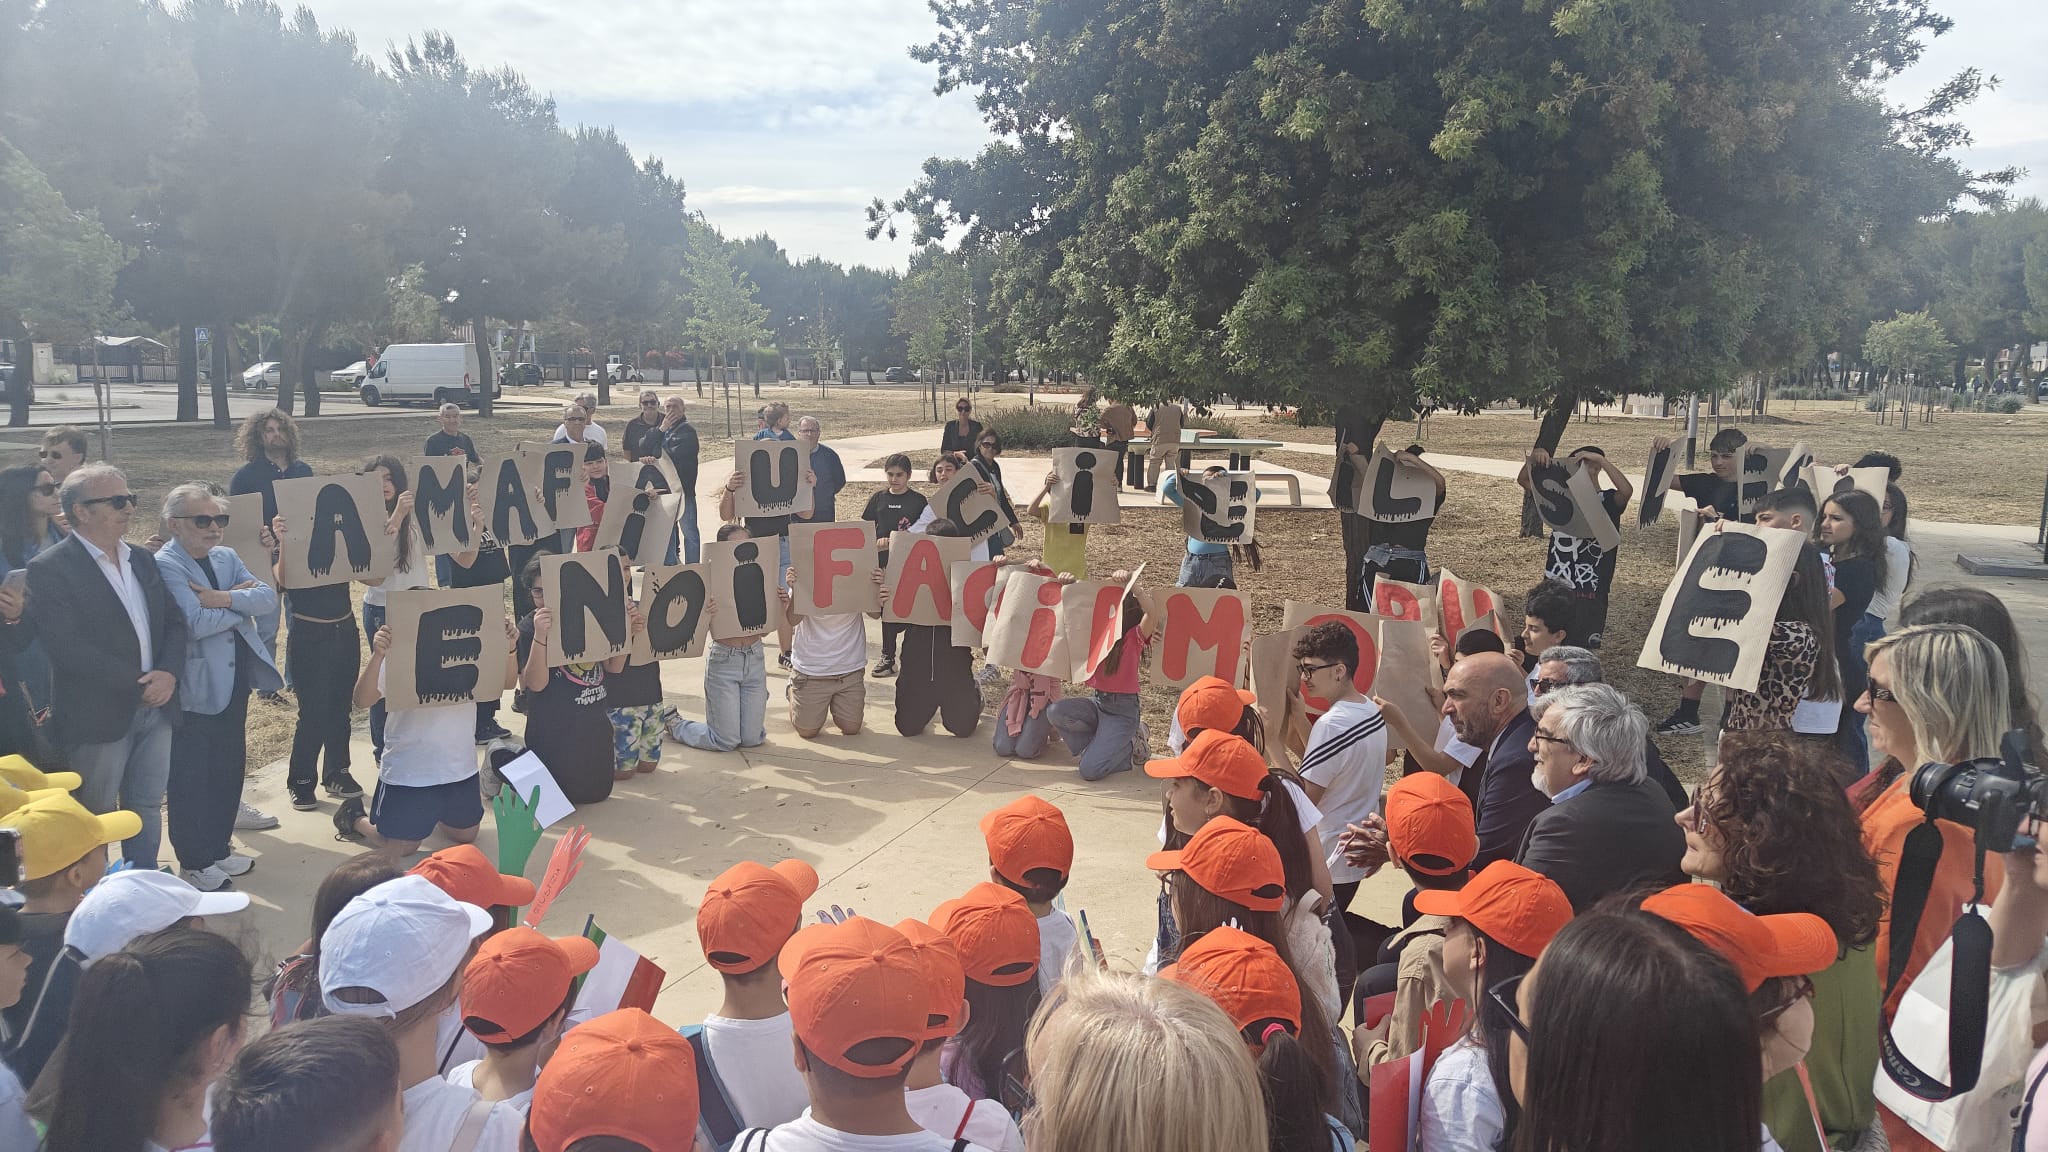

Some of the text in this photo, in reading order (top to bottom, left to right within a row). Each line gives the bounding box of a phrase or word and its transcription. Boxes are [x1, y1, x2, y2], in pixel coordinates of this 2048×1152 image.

[308, 484, 372, 577] A
[415, 604, 483, 703] E
[1882, 1034, 1922, 1087] Canon
